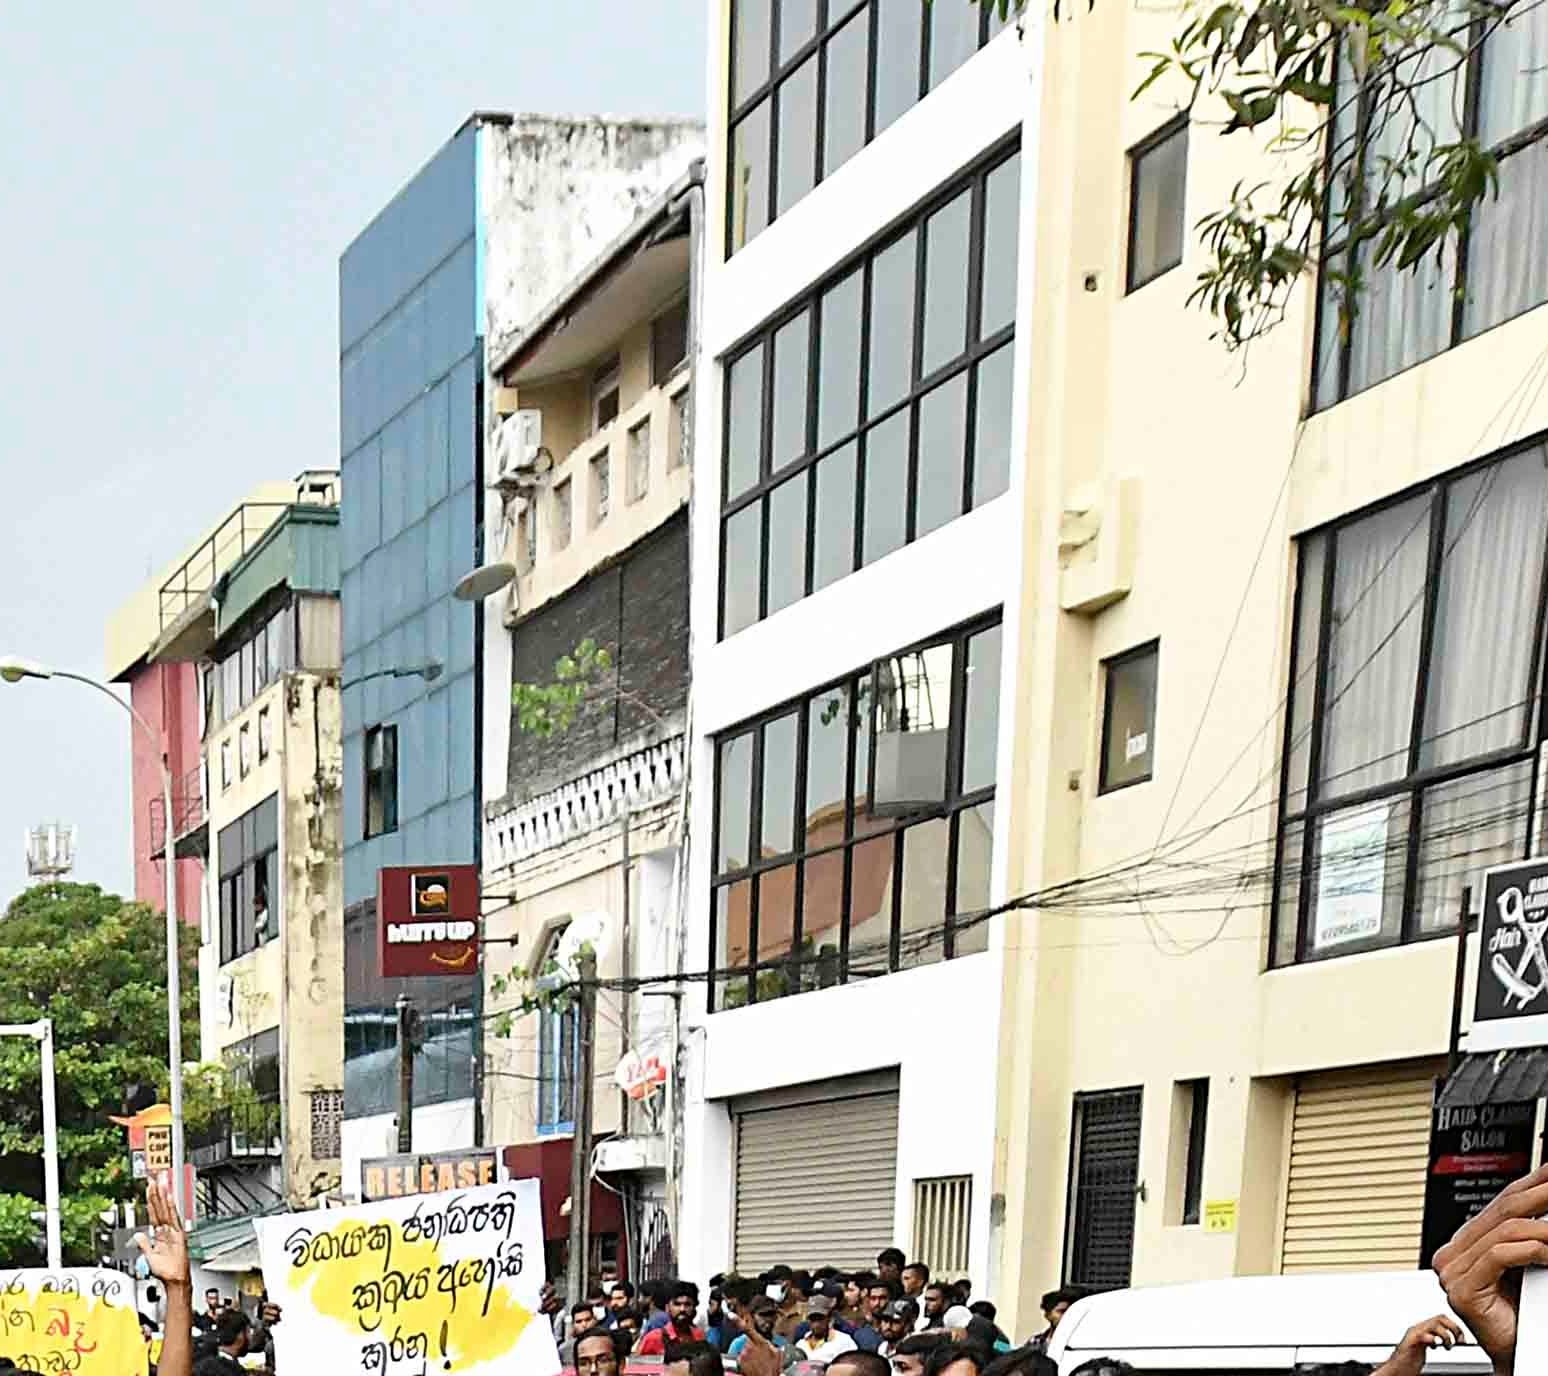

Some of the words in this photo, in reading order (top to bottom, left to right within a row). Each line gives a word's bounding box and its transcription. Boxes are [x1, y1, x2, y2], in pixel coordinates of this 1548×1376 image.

[364, 1158, 496, 1199] RELEASE
[284, 1224, 392, 1272] විධායක
[402, 1192, 516, 1251] ජනාධිපති
